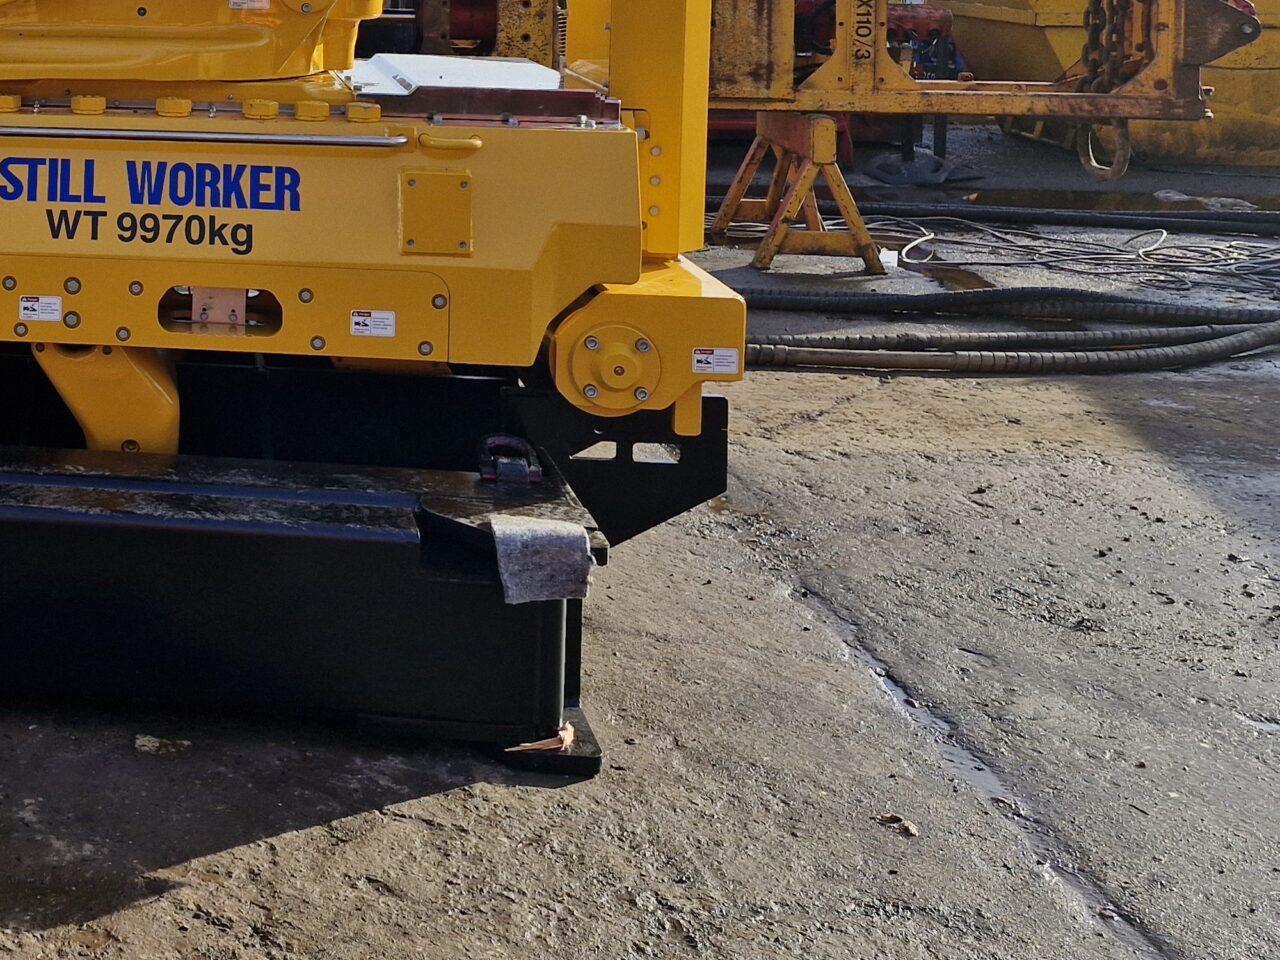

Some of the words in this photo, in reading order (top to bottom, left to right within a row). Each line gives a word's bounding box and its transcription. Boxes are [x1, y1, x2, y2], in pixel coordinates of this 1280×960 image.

[126, 160, 301, 211] WORKER
[46, 209, 108, 241] WT
[116, 212, 253, 255] 9970kg
